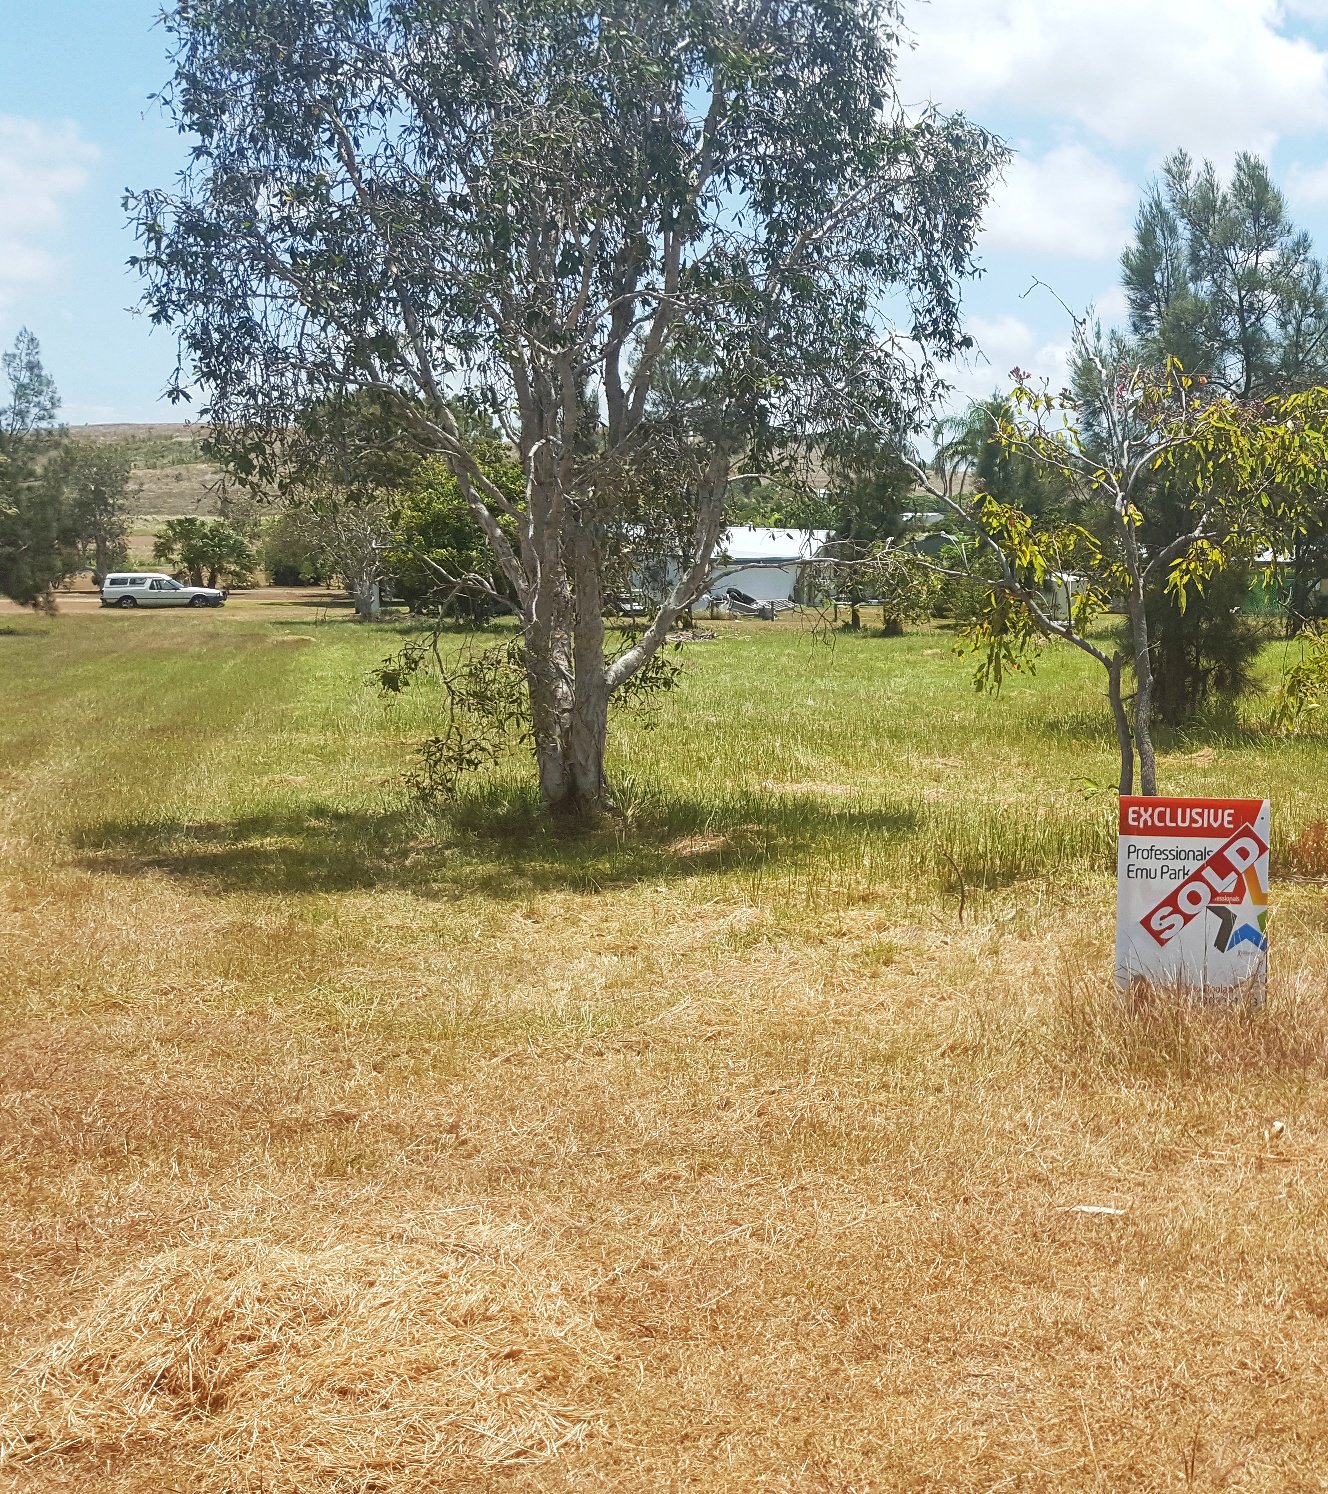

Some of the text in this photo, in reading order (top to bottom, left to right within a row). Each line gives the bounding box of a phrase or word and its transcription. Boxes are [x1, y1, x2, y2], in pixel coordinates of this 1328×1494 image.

[1128, 806, 1235, 828] EXCLUSIVE
[1126, 864, 1190, 880] Emu Park
[1150, 836, 1260, 940] SOLD
